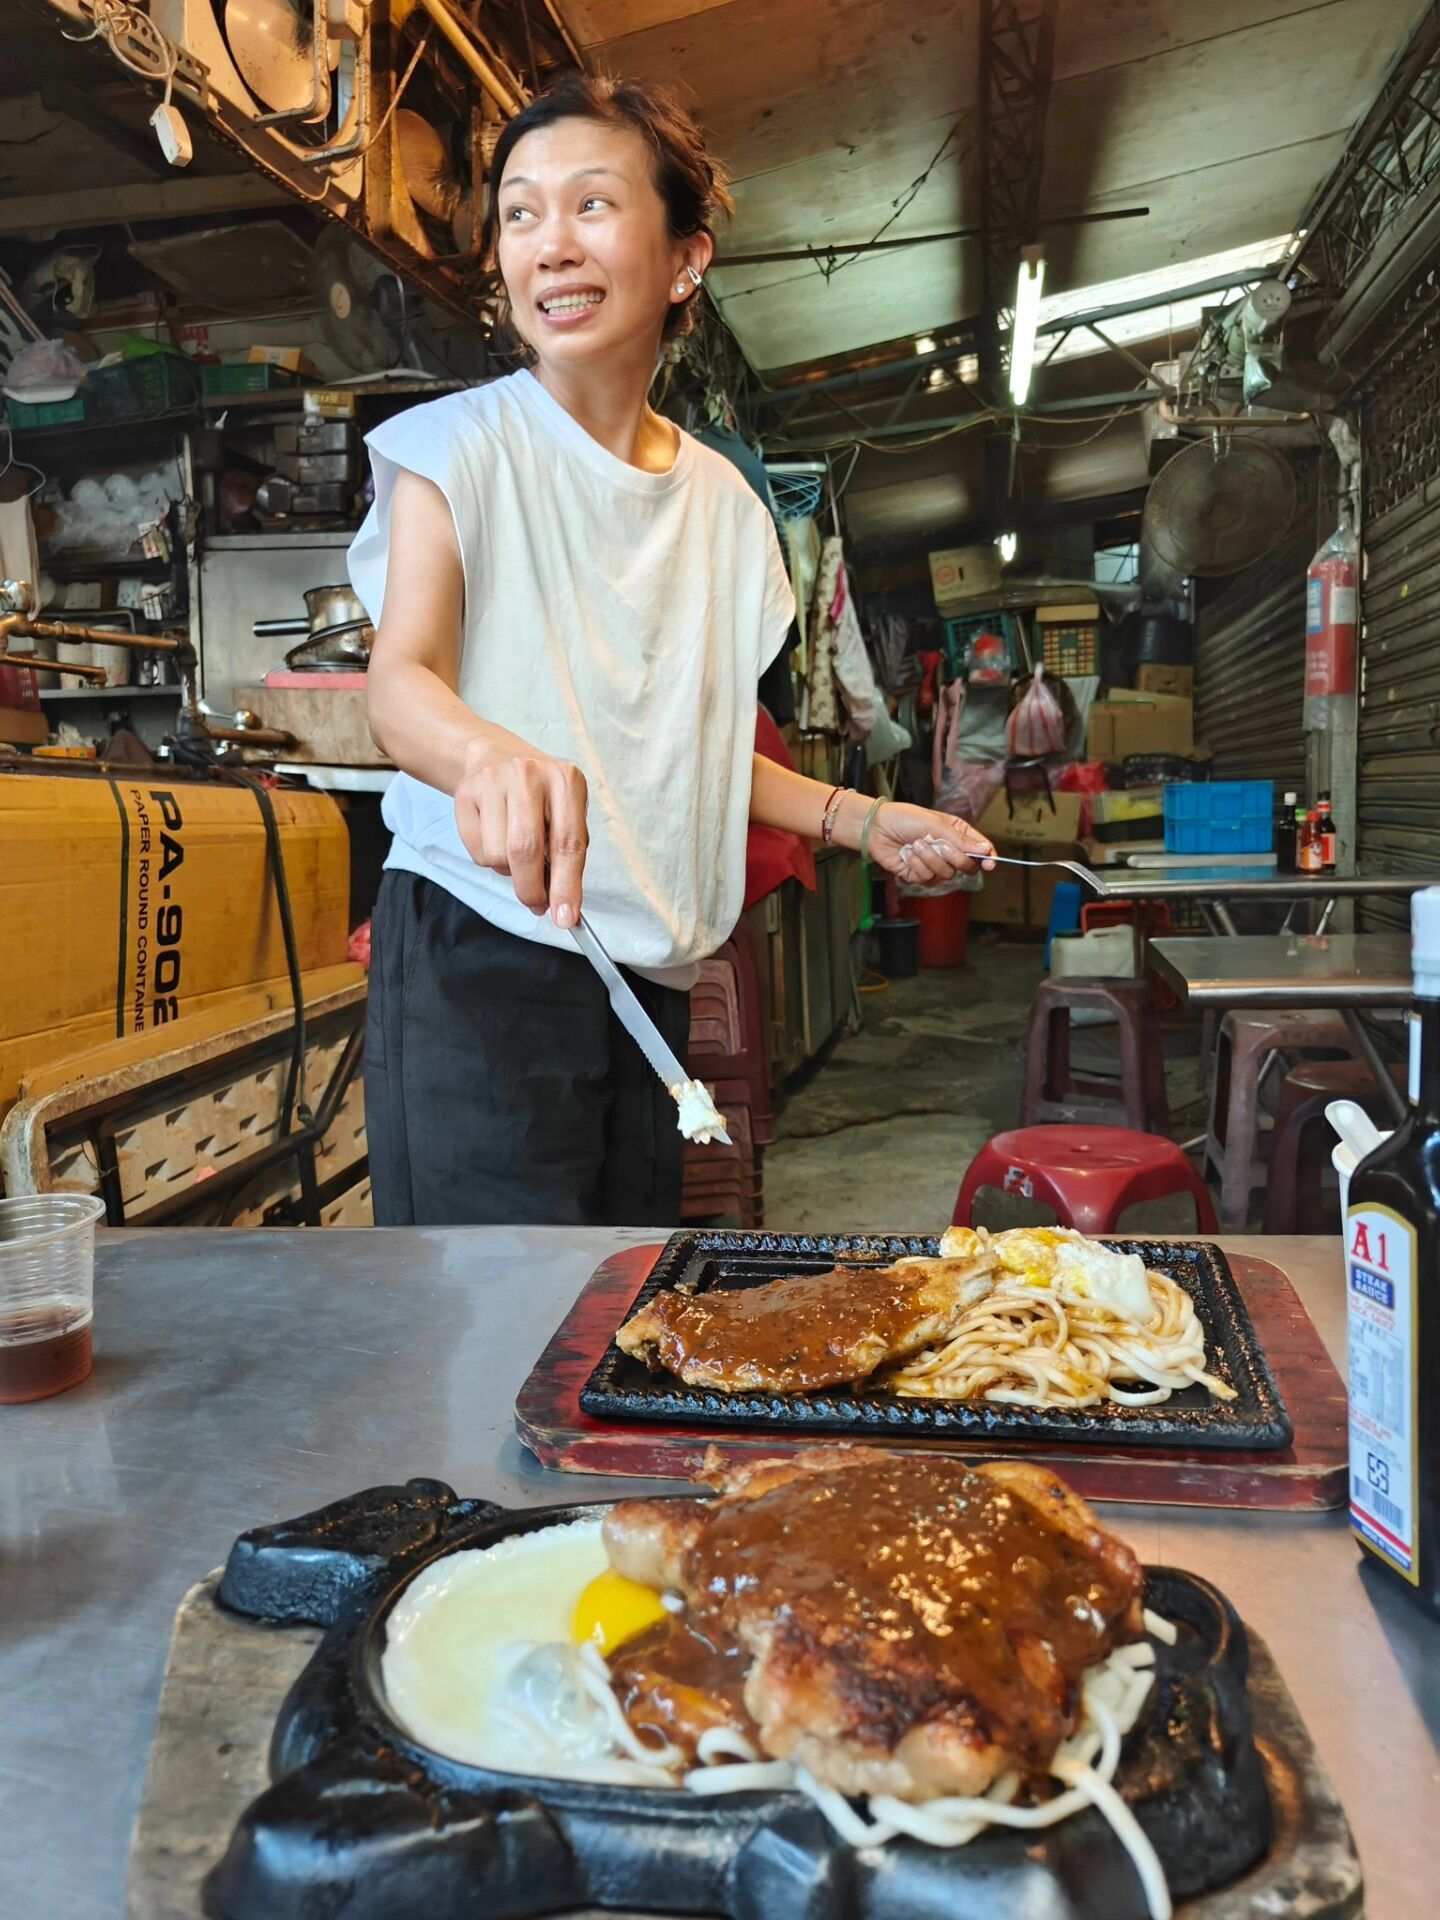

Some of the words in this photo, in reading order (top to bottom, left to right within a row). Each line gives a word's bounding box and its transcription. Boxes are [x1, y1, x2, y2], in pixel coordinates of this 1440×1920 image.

[130, 789, 151, 853] PAPER
[138, 859, 150, 929] ROUND
[1351, 1220, 1389, 1272] A1
[1355, 1268, 1388, 1293] STEAK
[1355, 1279, 1389, 1305] SAUCE
